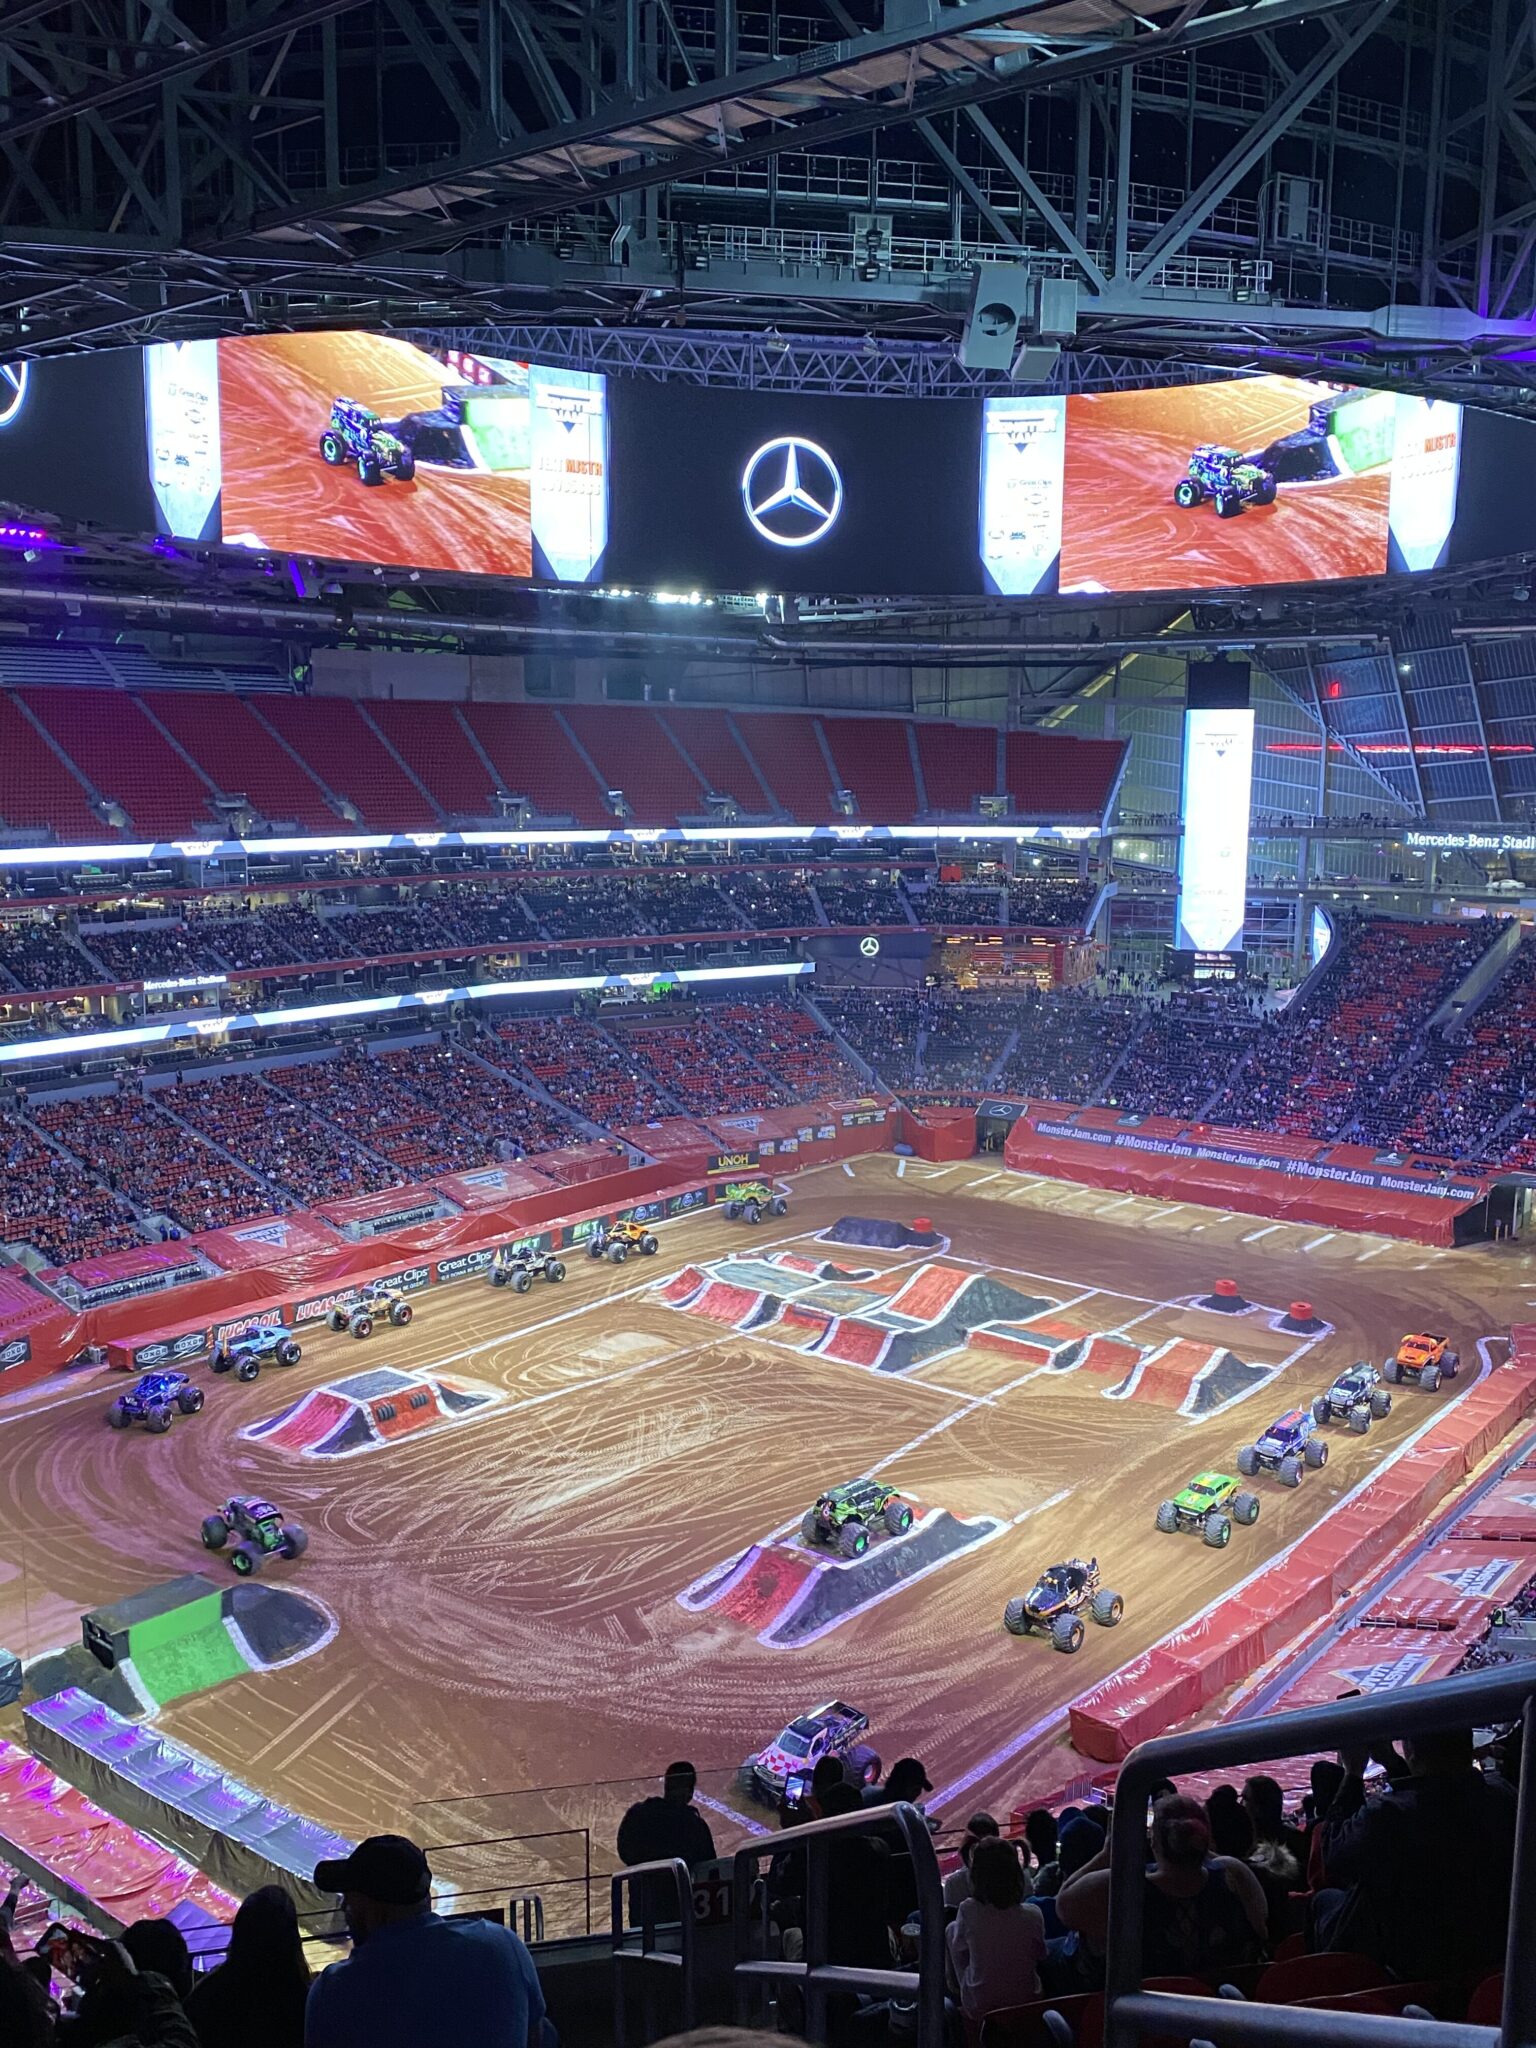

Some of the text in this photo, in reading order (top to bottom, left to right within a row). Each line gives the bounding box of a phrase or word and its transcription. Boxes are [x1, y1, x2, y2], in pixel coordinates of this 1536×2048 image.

[1406, 832, 1500, 847] Mercedes-Benz
[144, 978, 197, 991] Mercedes-Benz
[197, 975, 226, 985] Stadium
[718, 1153, 749, 1167] UNOH
[1037, 1121, 1475, 1200] MonsterJam.com #MonsterJam MonsterJam.com #MonsterJam MonsterJam.com
[437, 1251, 492, 1273] Great Clips
[373, 1274, 403, 1291] Great
[403, 1267, 429, 1282] Clips
[296, 1295, 336, 1322] LUCAS
[258, 1309, 282, 1327] OIL
[1, 1344, 27, 1359] ROXOR
[175, 1337, 204, 1350] ROXOR
[137, 1346, 167, 1360] ROXOR
[692, 1886, 729, 1919] 31
